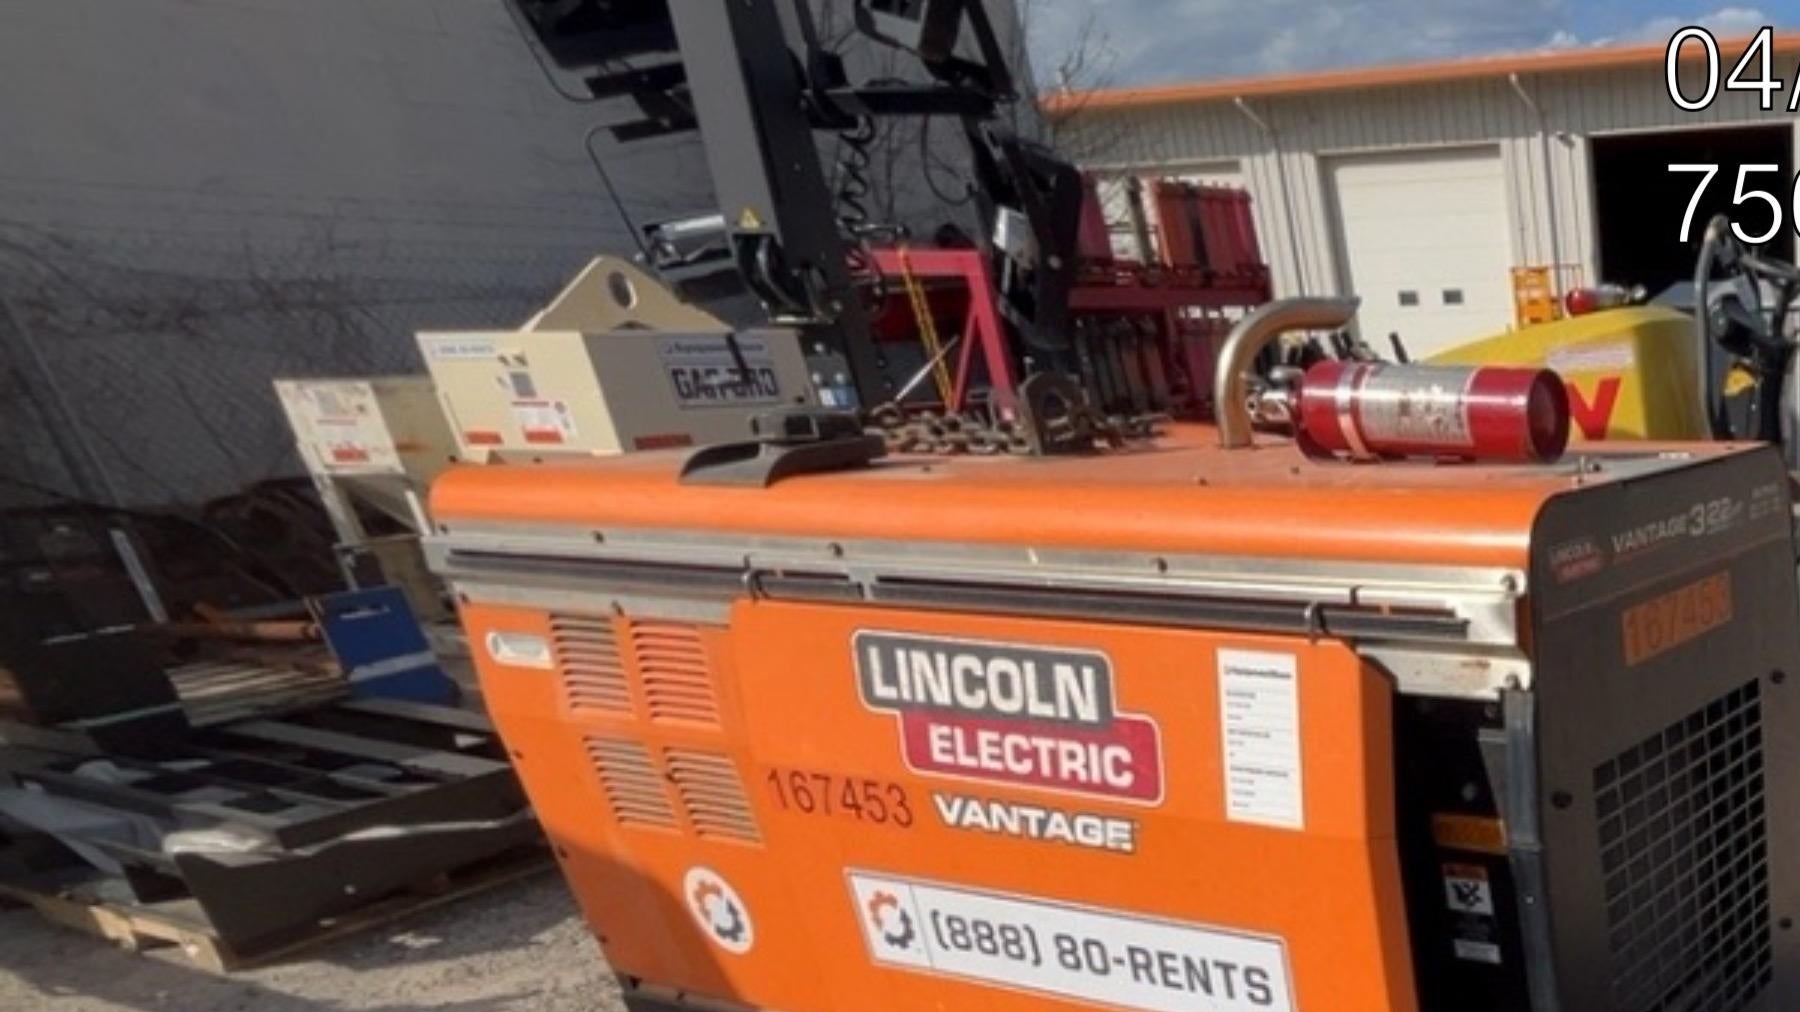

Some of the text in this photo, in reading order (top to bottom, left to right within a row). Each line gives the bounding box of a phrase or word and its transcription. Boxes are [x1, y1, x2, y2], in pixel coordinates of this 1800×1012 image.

[867, 646, 1100, 723] LINCOLN
[928, 724, 1135, 789] ELECTRIC
[767, 768, 913, 828] 167453
[933, 793, 1135, 852] VANTAGE
[930, 909, 1274, 1007] (888) 80-RENTS
